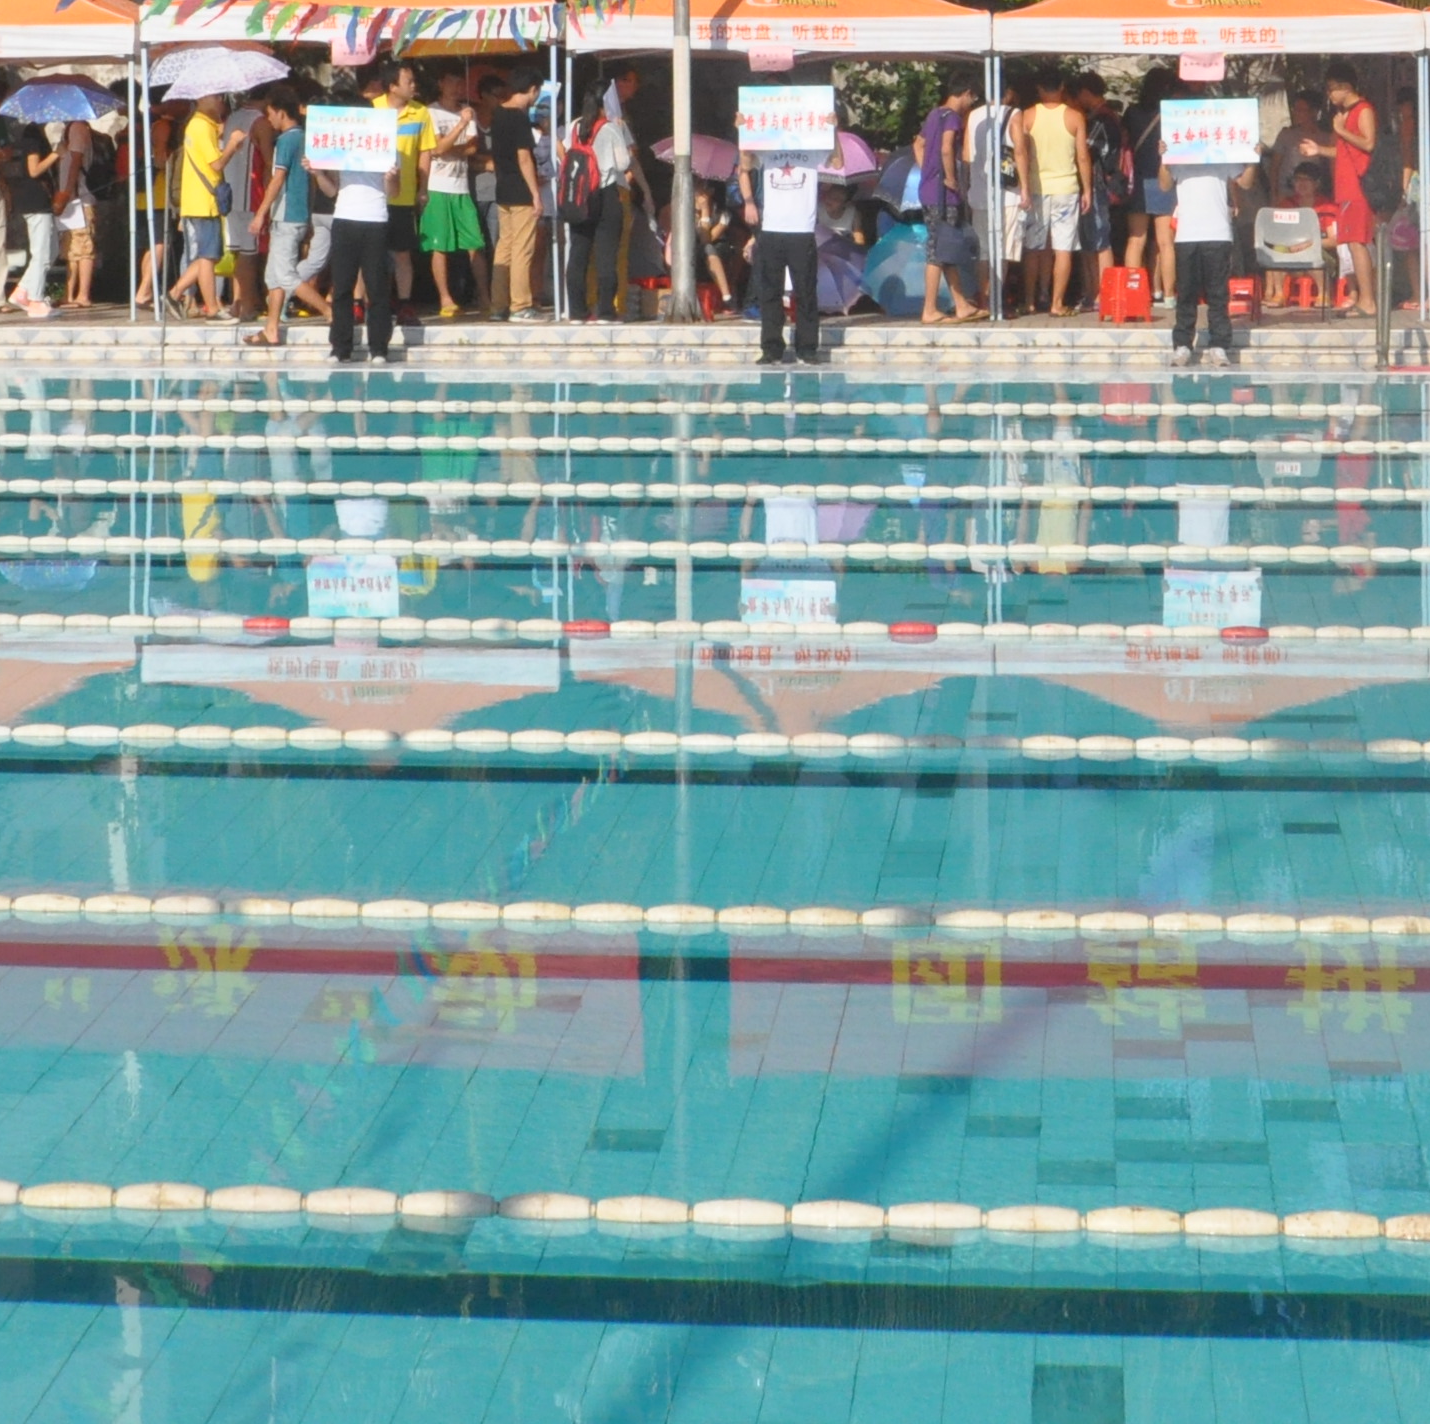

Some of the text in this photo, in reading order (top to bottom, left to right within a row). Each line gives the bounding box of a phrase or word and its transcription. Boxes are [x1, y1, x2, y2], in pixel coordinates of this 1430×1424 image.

[1170, 125, 1251, 146] 生命科学学院
